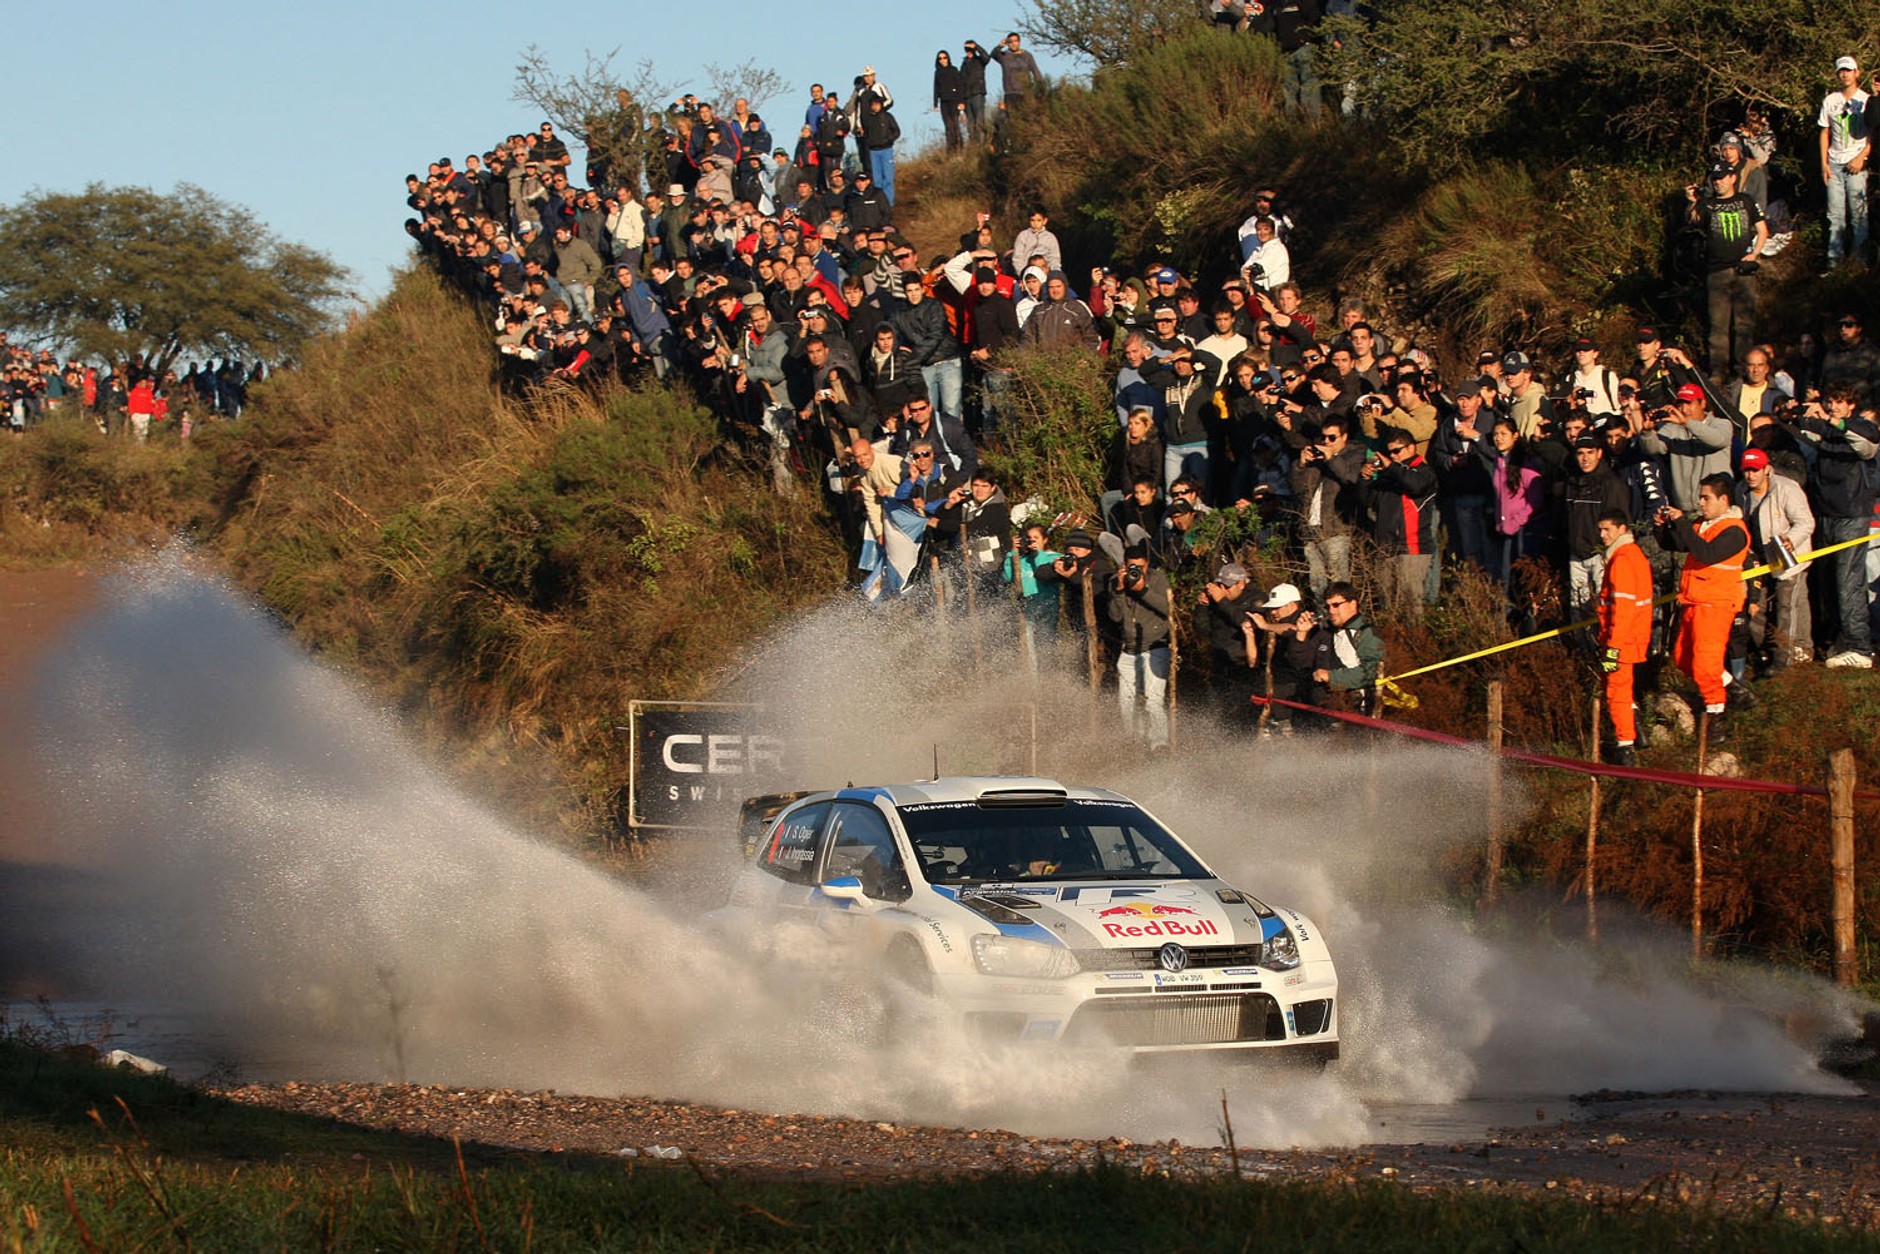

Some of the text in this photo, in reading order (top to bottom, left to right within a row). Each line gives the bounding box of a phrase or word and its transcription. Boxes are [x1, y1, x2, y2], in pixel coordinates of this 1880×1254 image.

[902, 803, 976, 812] Volkswagen
[1102, 919, 1219, 938] Red Bull
